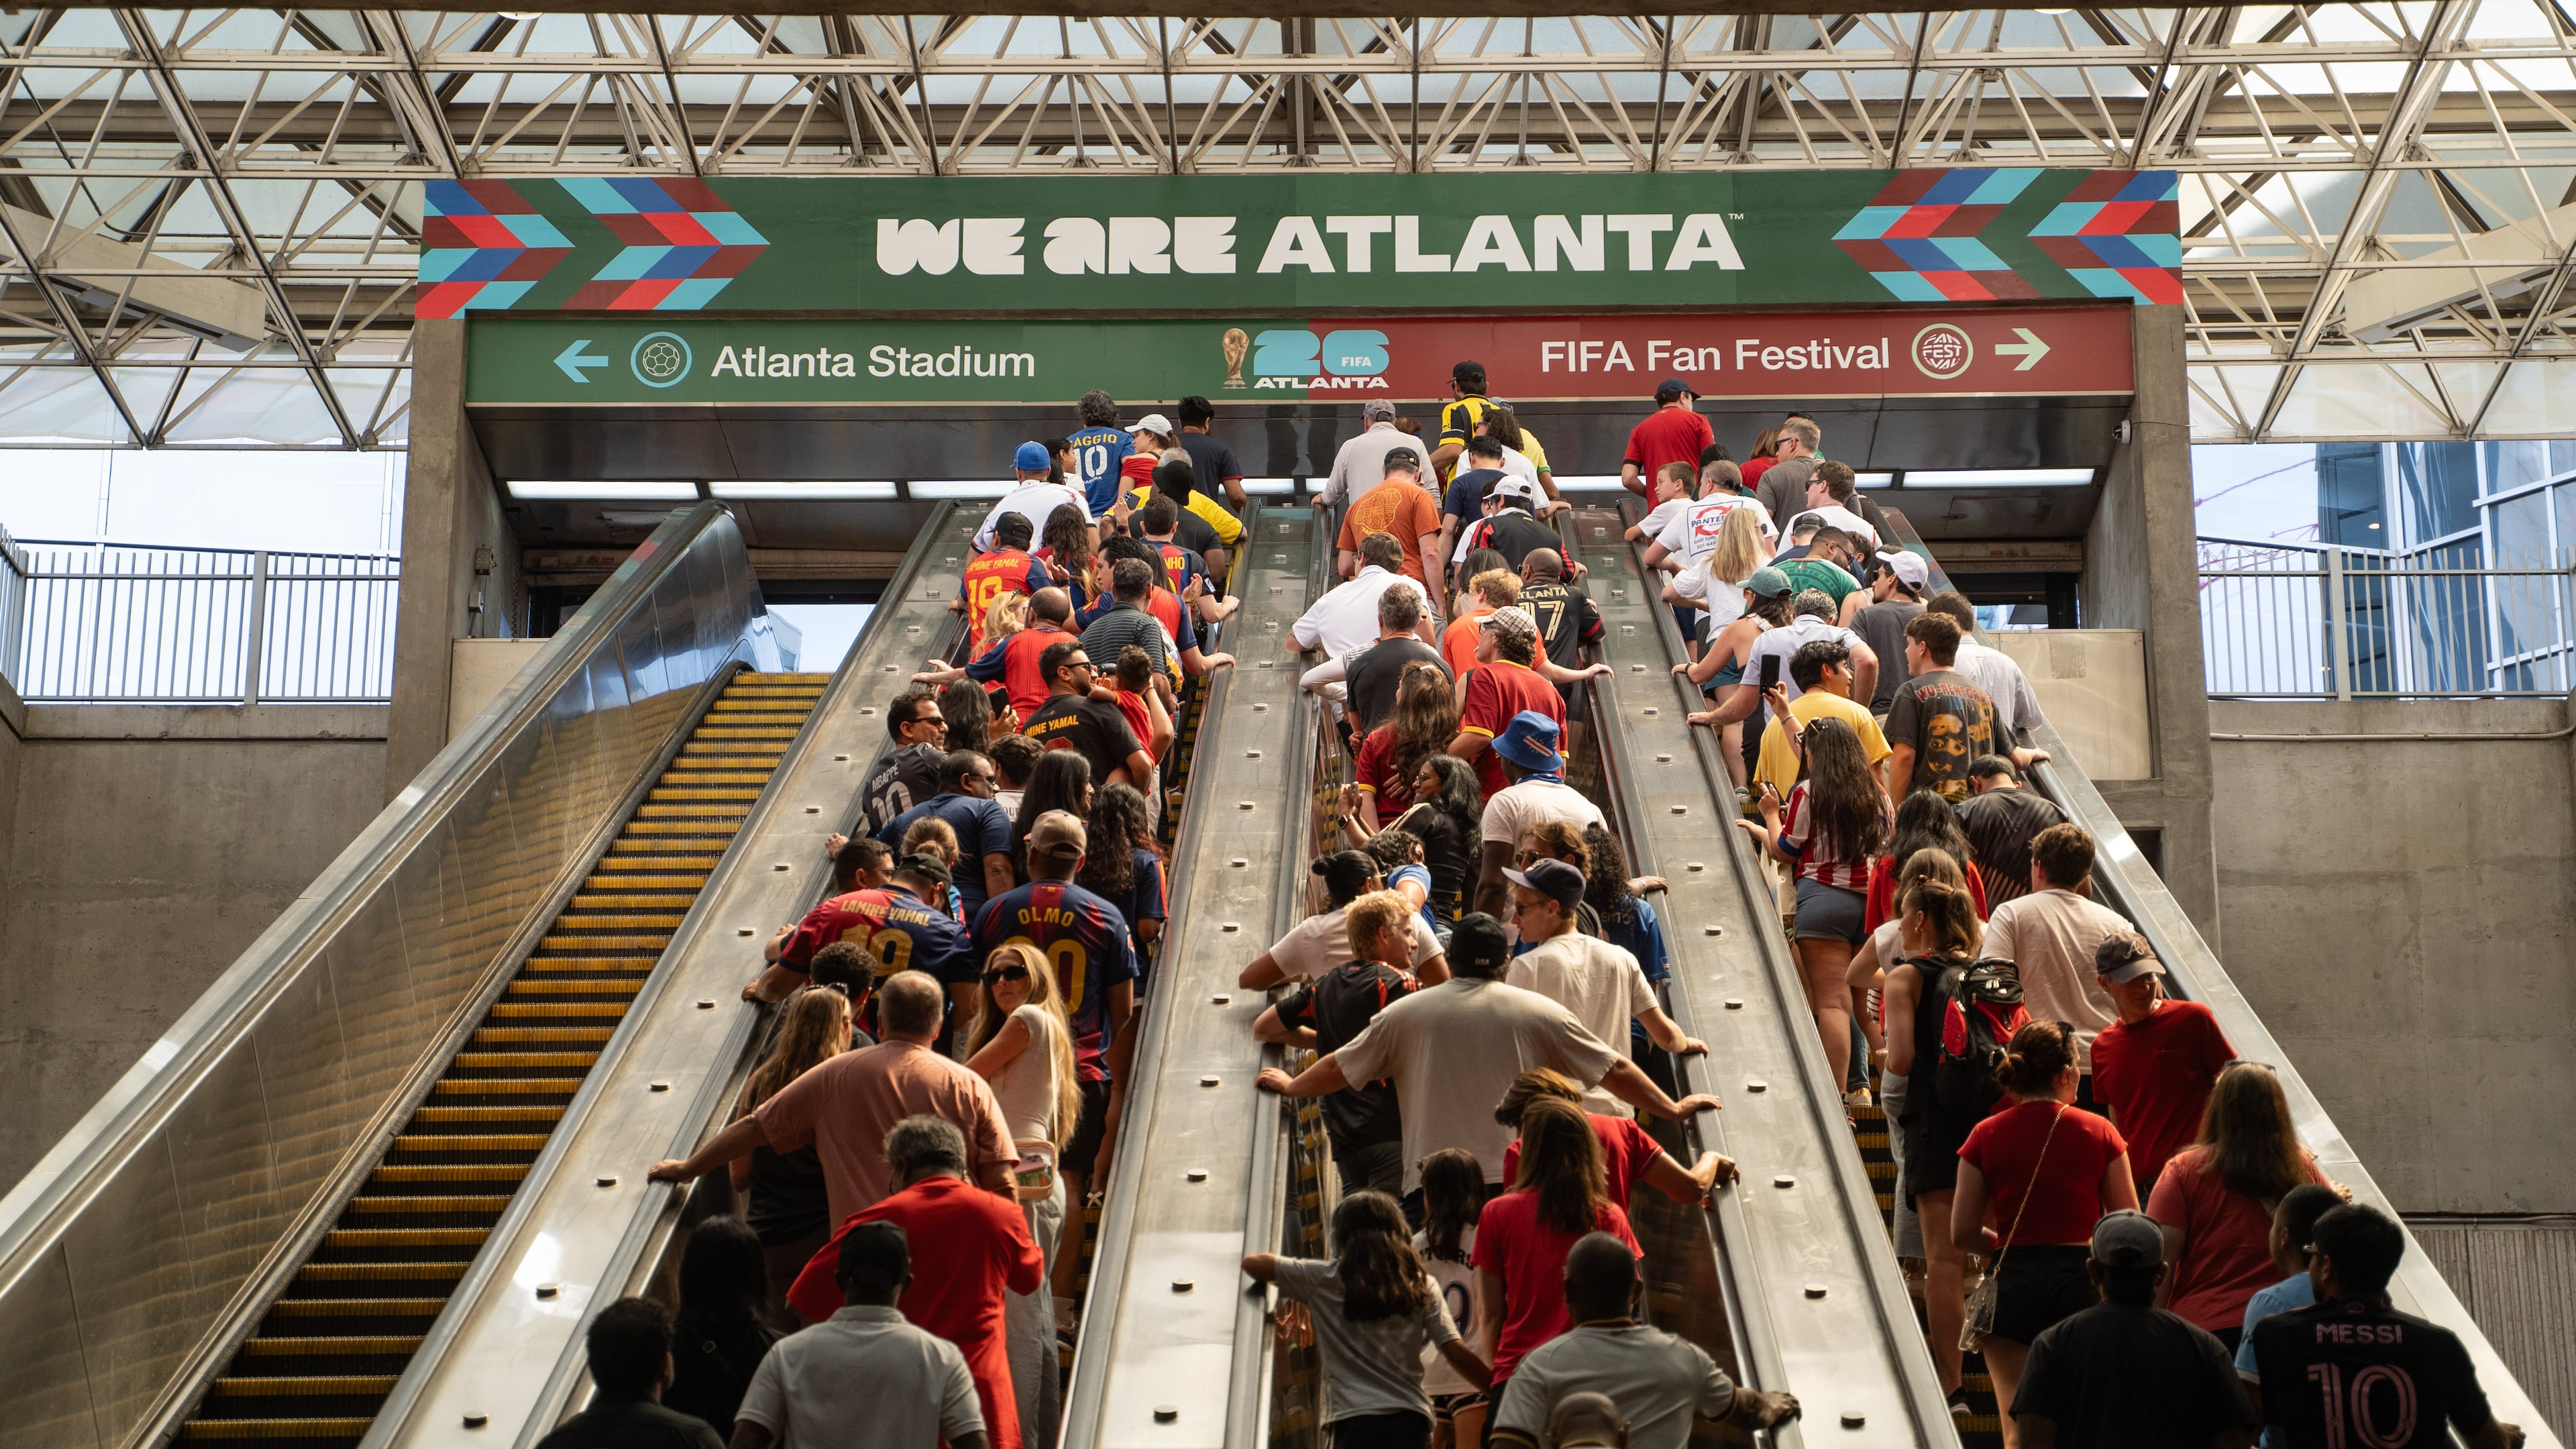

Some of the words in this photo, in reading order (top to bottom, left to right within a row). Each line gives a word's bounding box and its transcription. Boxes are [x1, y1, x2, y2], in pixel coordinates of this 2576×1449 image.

[877, 217, 1026, 276] WE
[1043, 216, 1236, 275] ARE
[1923, 333, 1962, 345] FAN
[710, 345, 856, 378] Atlanta
[868, 345, 1034, 377] Stadium
[1253, 329, 1389, 376] 26
[1341, 356, 1373, 367] FIFA
[1542, 340, 1635, 372] FIFA
[1648, 340, 1721, 372] Fan
[1735, 337, 1890, 370] Festival
[1922, 344, 1963, 358] FEST
[1253, 376, 1389, 389] ATLANTA
[1069, 433, 1118, 447] AGGIO
[1073, 445, 1108, 478] 10
[993, 558, 1019, 569] YAMAL
[1048, 714, 1079, 731] YAMAL
[871, 759, 900, 793] MBAPPÉ
[840, 899, 889, 920] LAMINE
[888, 906, 931, 927] YAMAL
[1017, 906, 1075, 928] OLMO
[1475, 957, 1490, 966] USA
[2316, 1323, 2403, 1344] MESSI
[2307, 1362, 2417, 1449] 10
